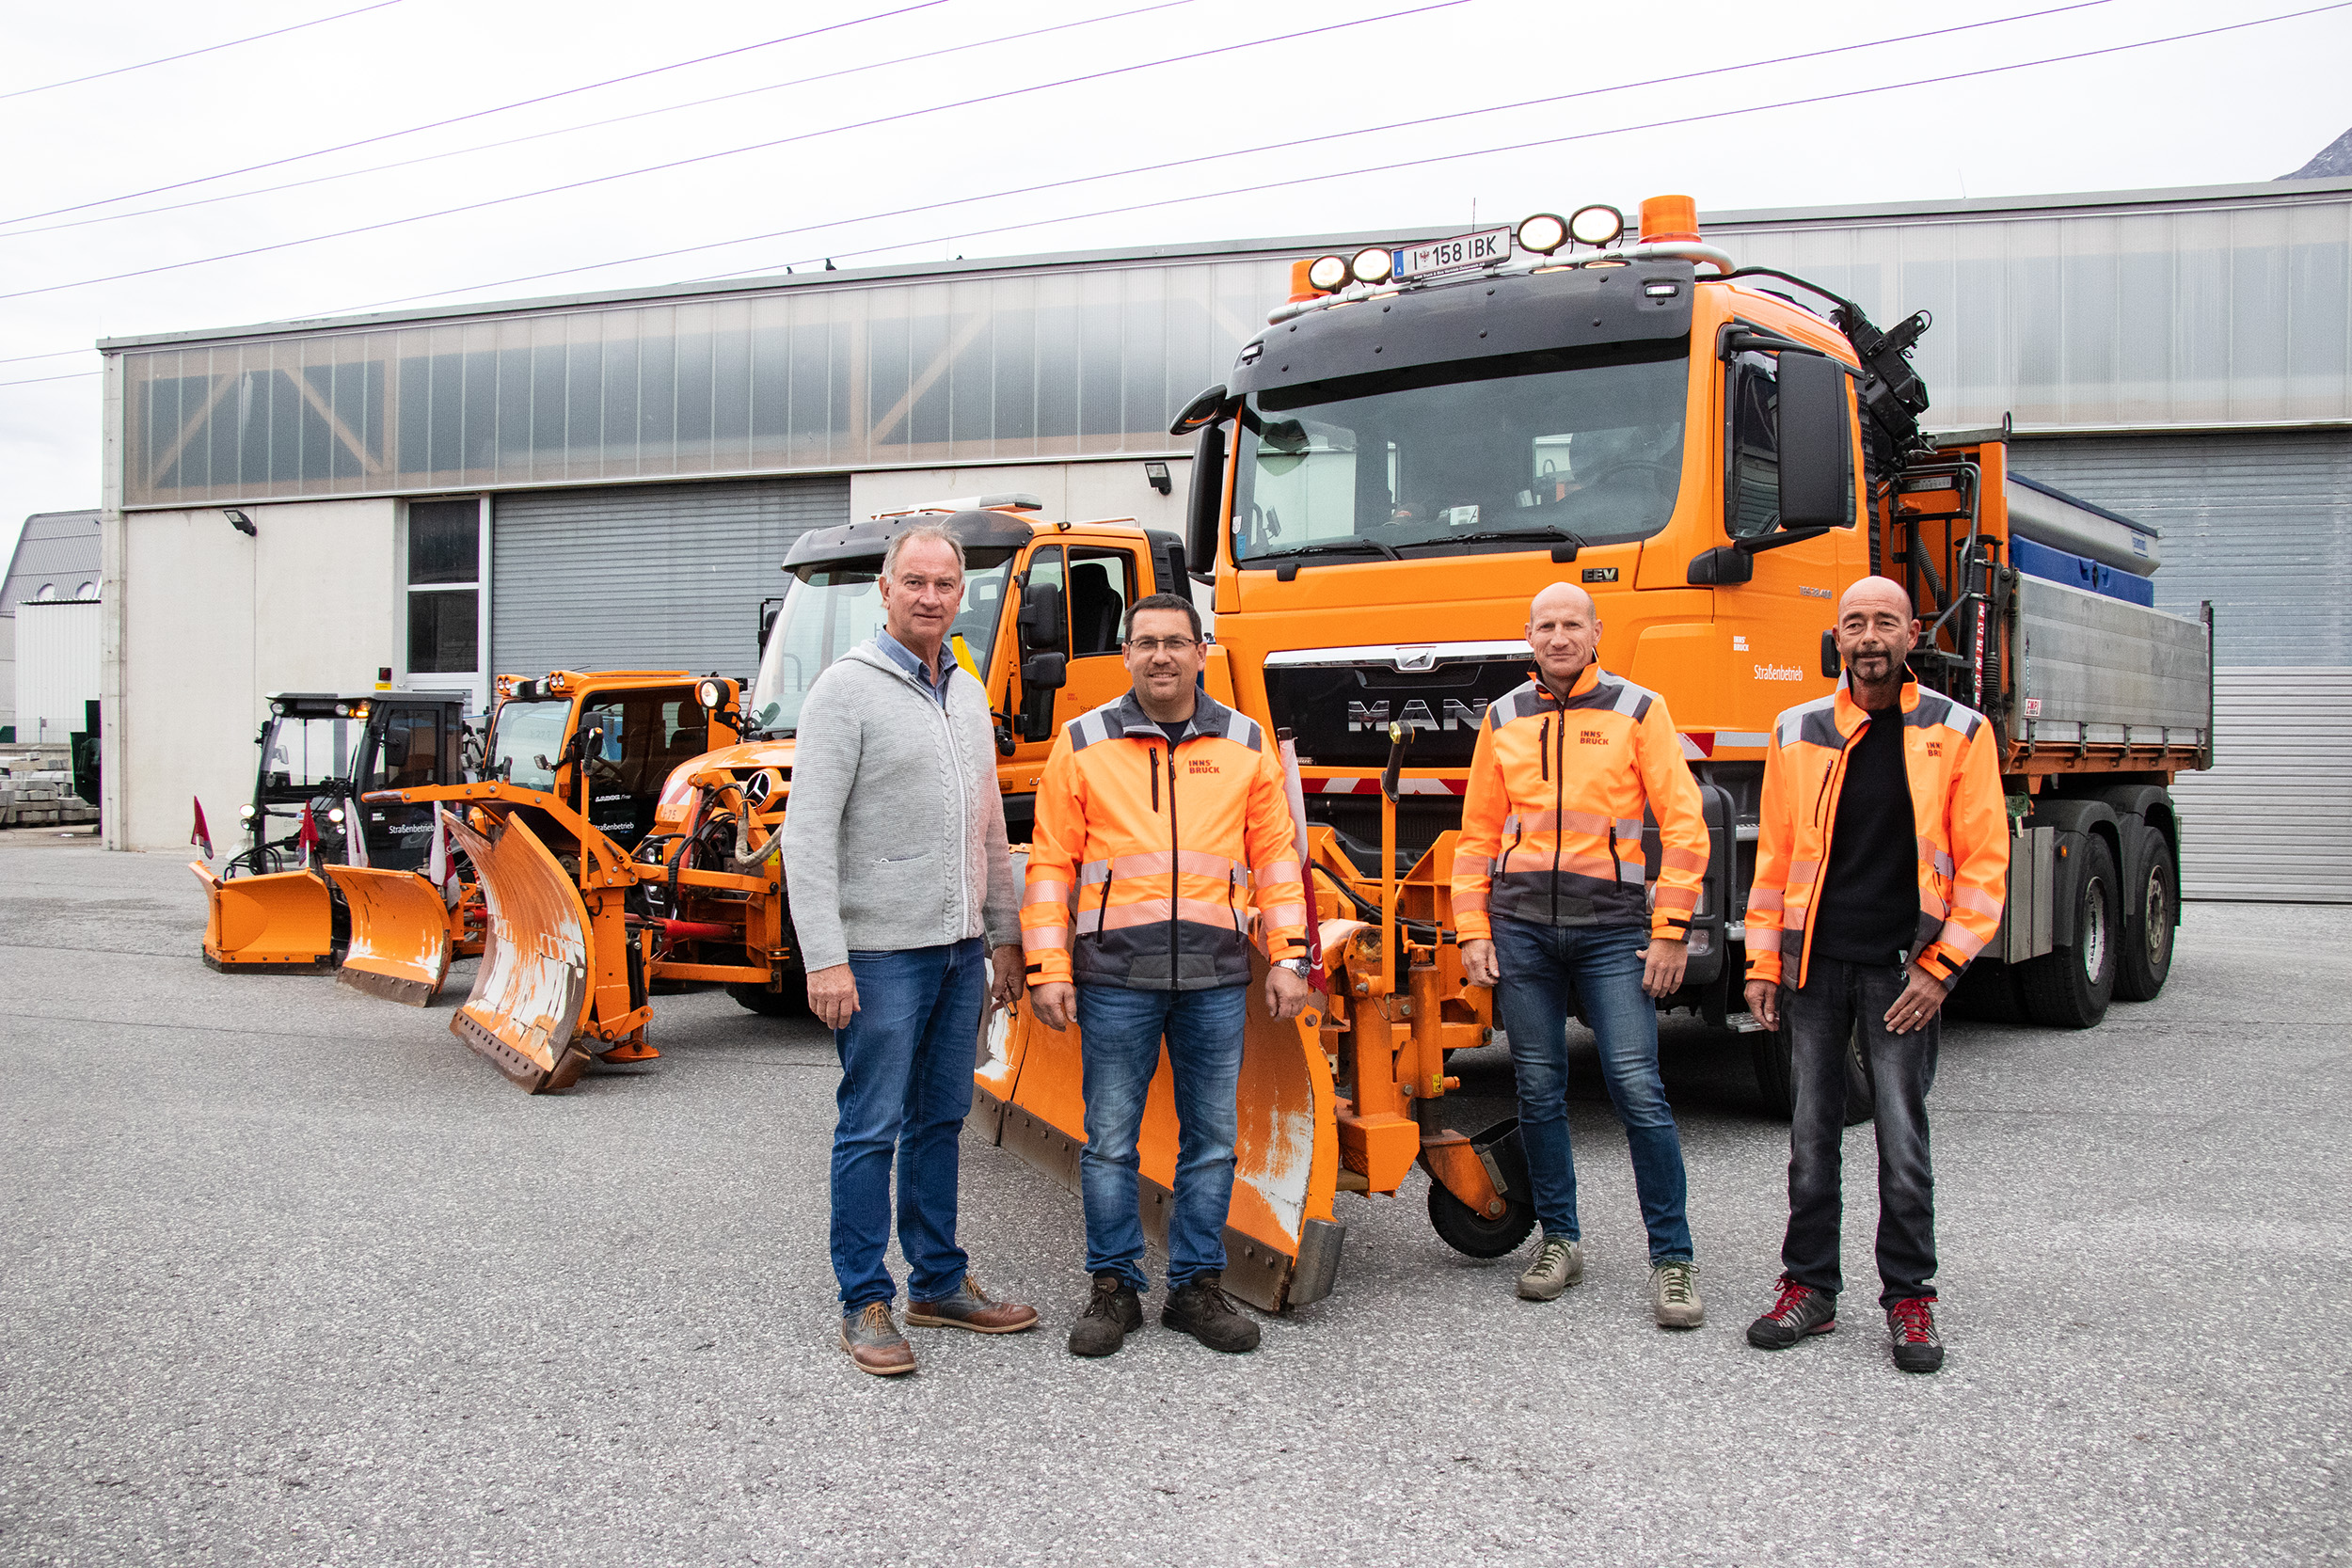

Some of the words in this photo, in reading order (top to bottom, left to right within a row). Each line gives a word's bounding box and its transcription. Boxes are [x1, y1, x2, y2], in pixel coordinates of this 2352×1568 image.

[1413, 250, 1418, 271] I
[1432, 242, 1463, 266] 158
[1468, 234, 1497, 260] IBK
[1583, 568, 1616, 580] EEV
[1754, 663, 1804, 682] Straßenbetrieb
[1348, 698, 1488, 732] MAN
[389, 823, 436, 834] Straßenbetrieb
[593, 821, 635, 832] traßenbetrieb
